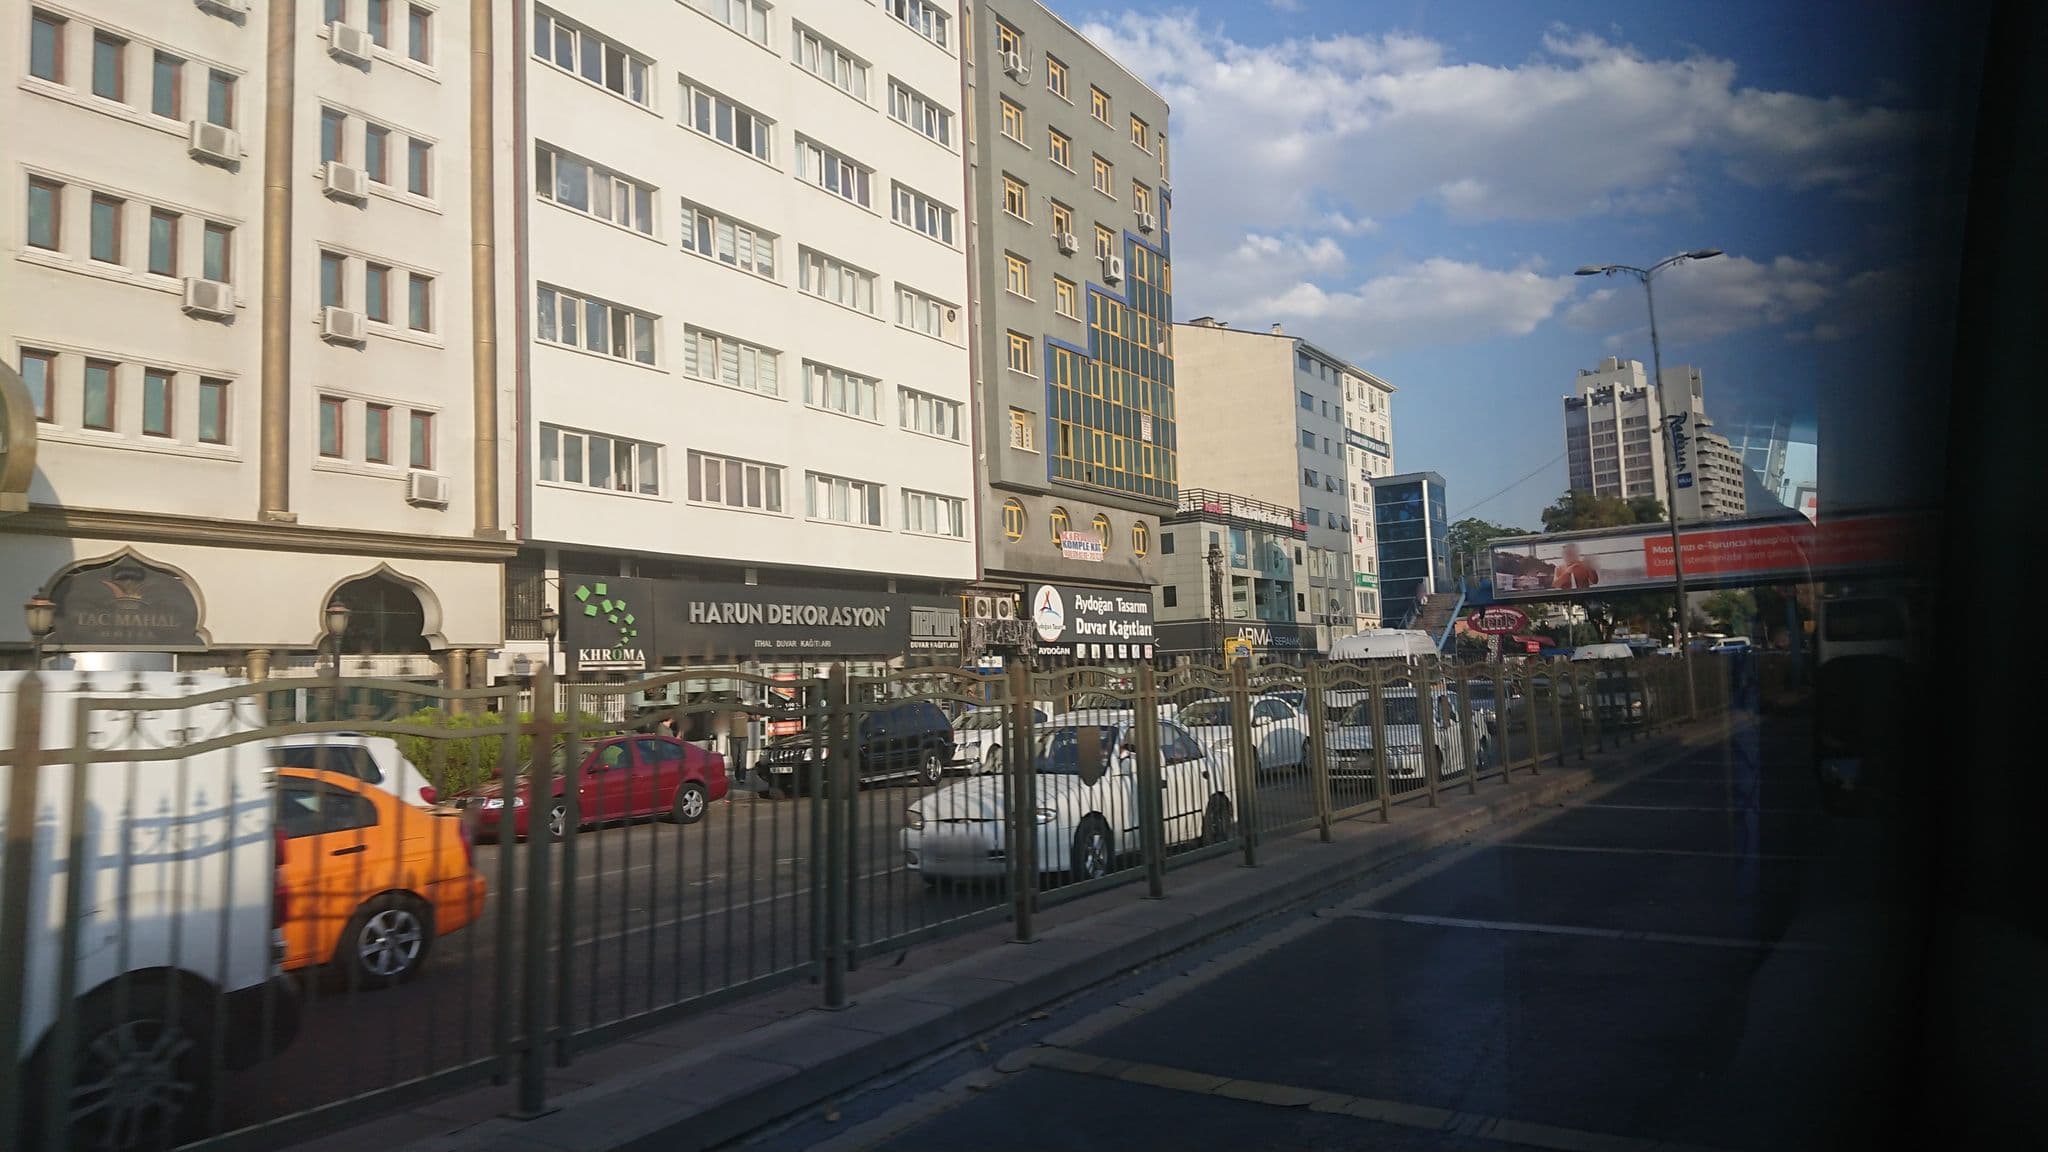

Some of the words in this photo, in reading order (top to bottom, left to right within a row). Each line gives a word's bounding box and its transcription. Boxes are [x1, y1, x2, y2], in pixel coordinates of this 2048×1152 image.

[1063, 540, 1089, 551] KOMPLE
[1075, 594, 1114, 616] Aydoğan
[1115, 597, 1149, 614] Tasarım
[689, 601, 763, 624] HARUN
[767, 604, 887, 627] DEKORASYON
[1076, 618, 1107, 635] Duvar
[1108, 619, 1153, 640] Kağıtları
[1237, 627, 1274, 646] ARMA
[776, 639, 797, 648] DUVAR
[910, 641, 930, 649] DUVAR
[1038, 645, 1071, 655] AYDOĞAN
[579, 648, 646, 661] KHROMA
